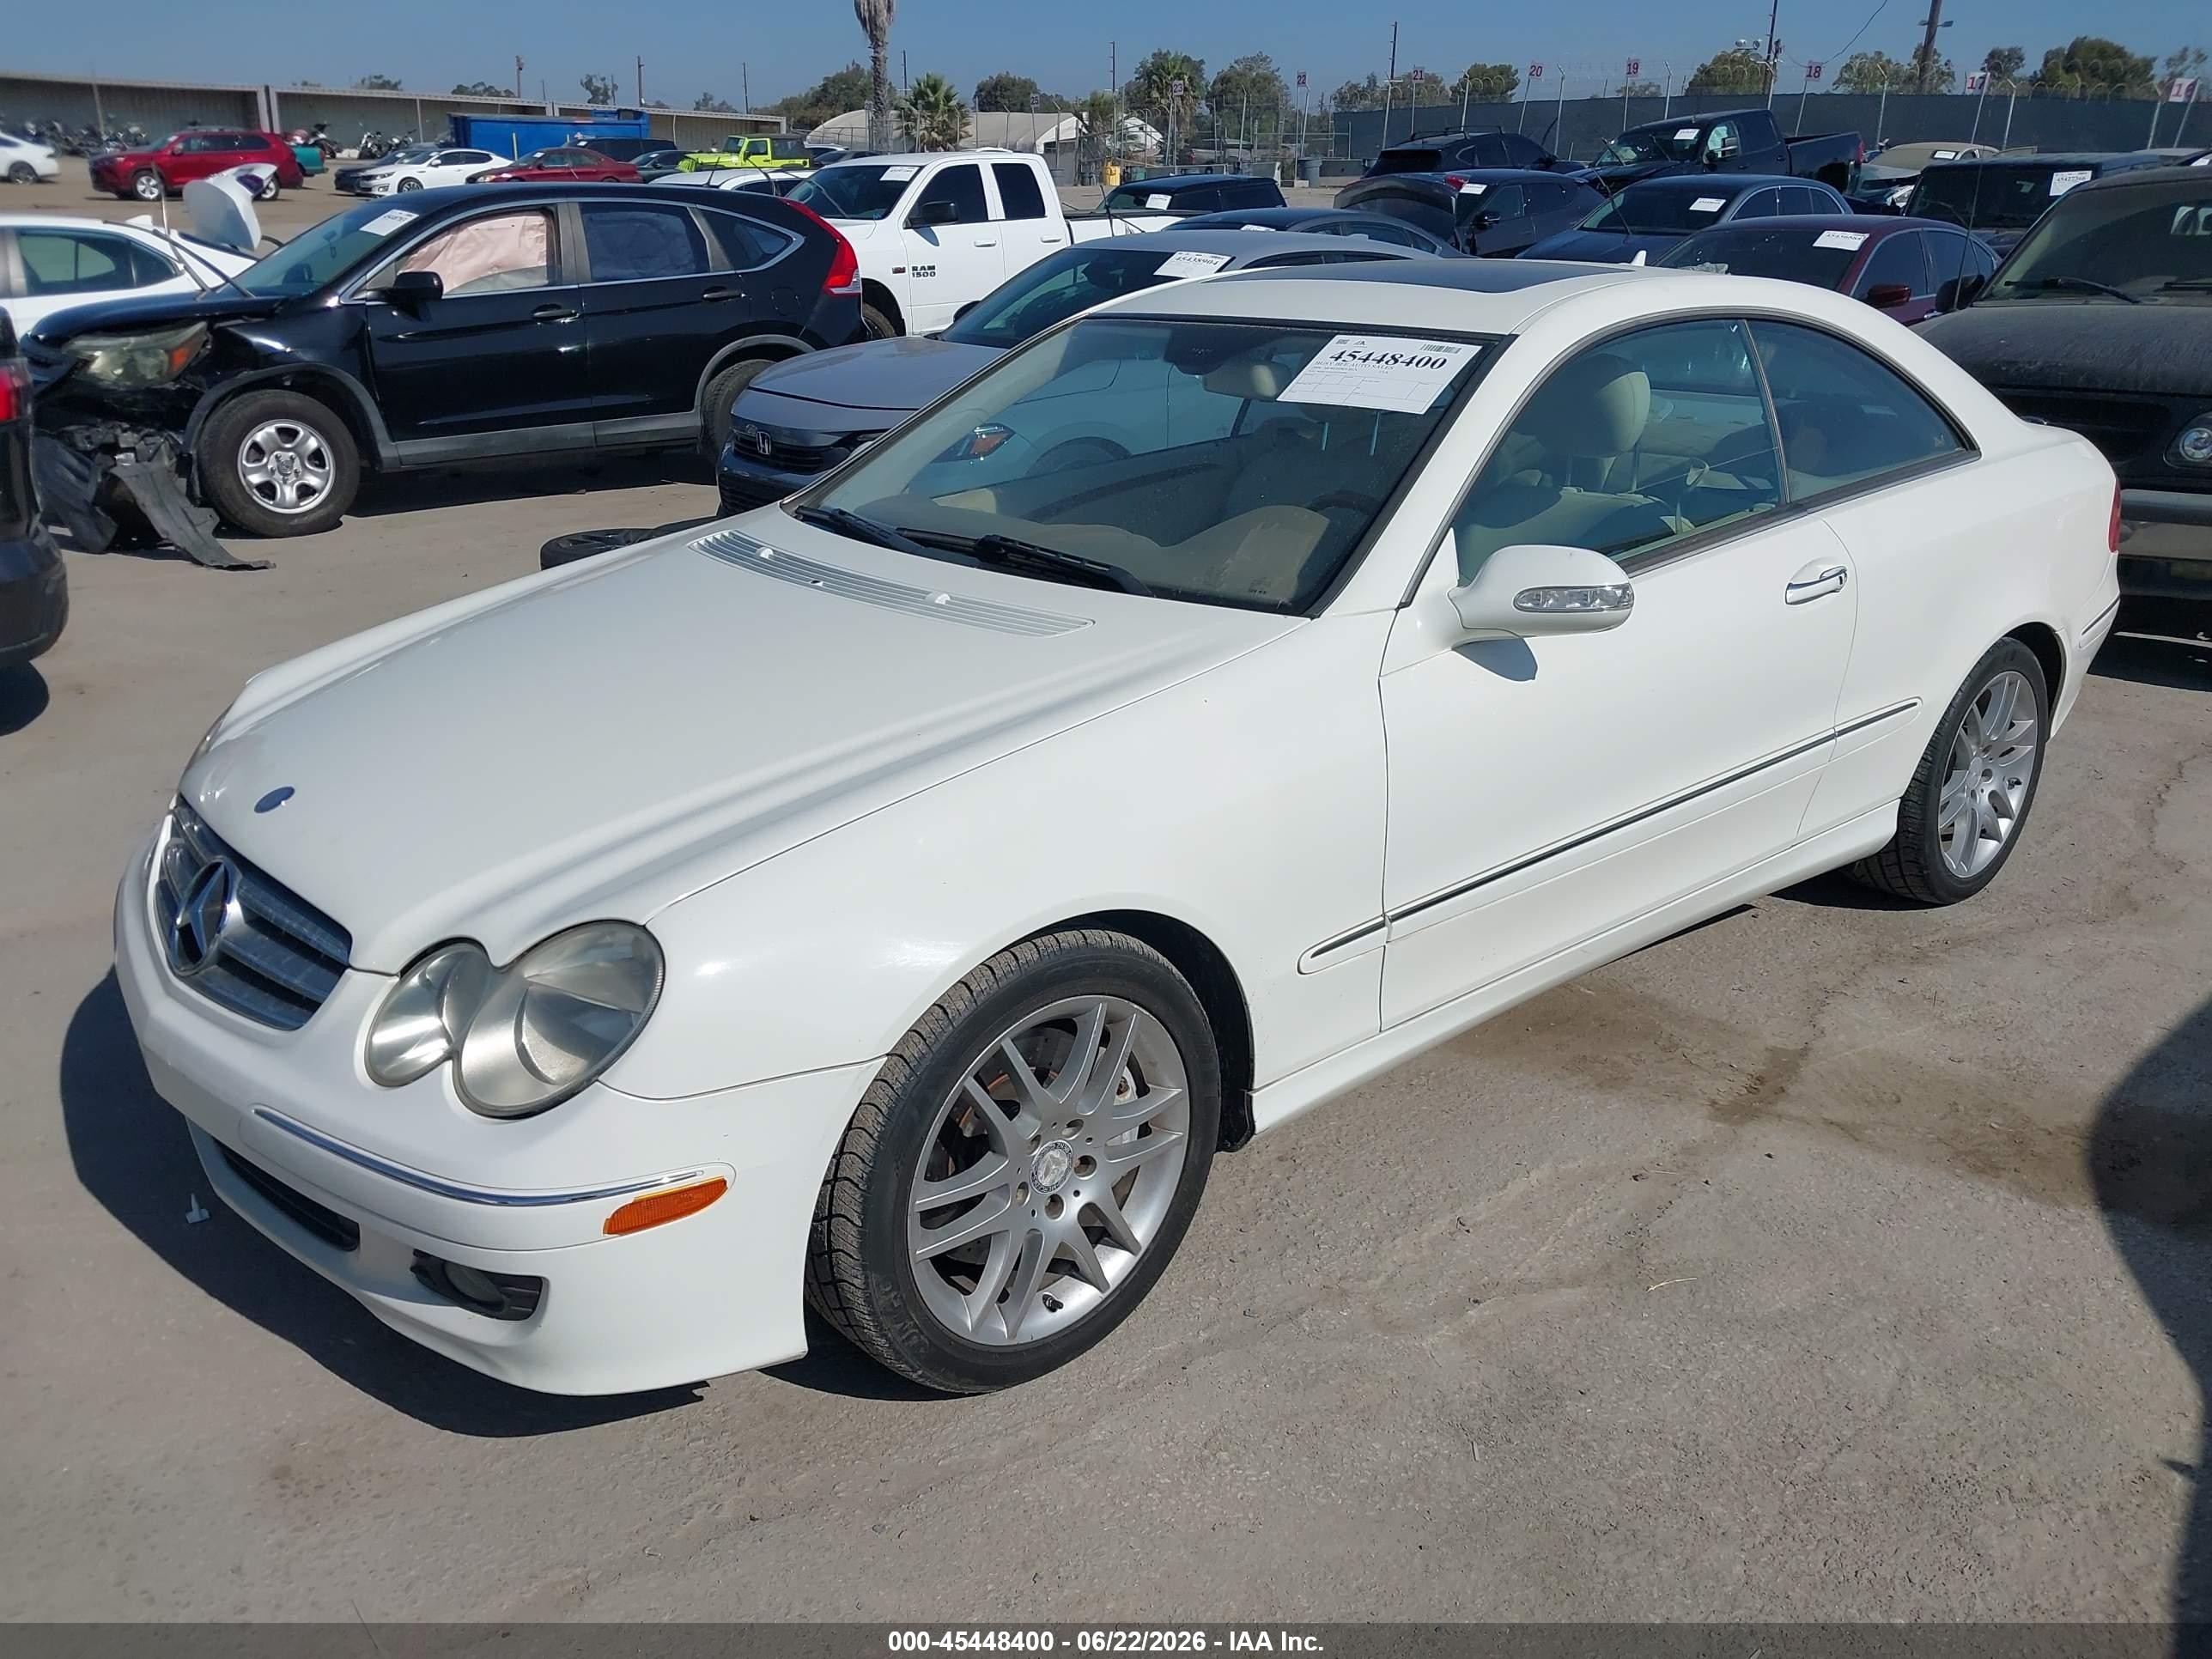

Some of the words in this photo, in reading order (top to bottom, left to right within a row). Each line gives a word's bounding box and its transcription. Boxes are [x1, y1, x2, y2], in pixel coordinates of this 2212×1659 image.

[1413, 70, 1424, 80] 21
[1529, 65, 1543, 77] 20
[1626, 63, 1638, 75] 19
[1806, 65, 1821, 79] 18
[1297, 75, 1306, 84] 22
[1966, 76, 1985, 90] 17
[1173, 83, 1183, 93] 23
[1328, 349, 1448, 370] 45448400
